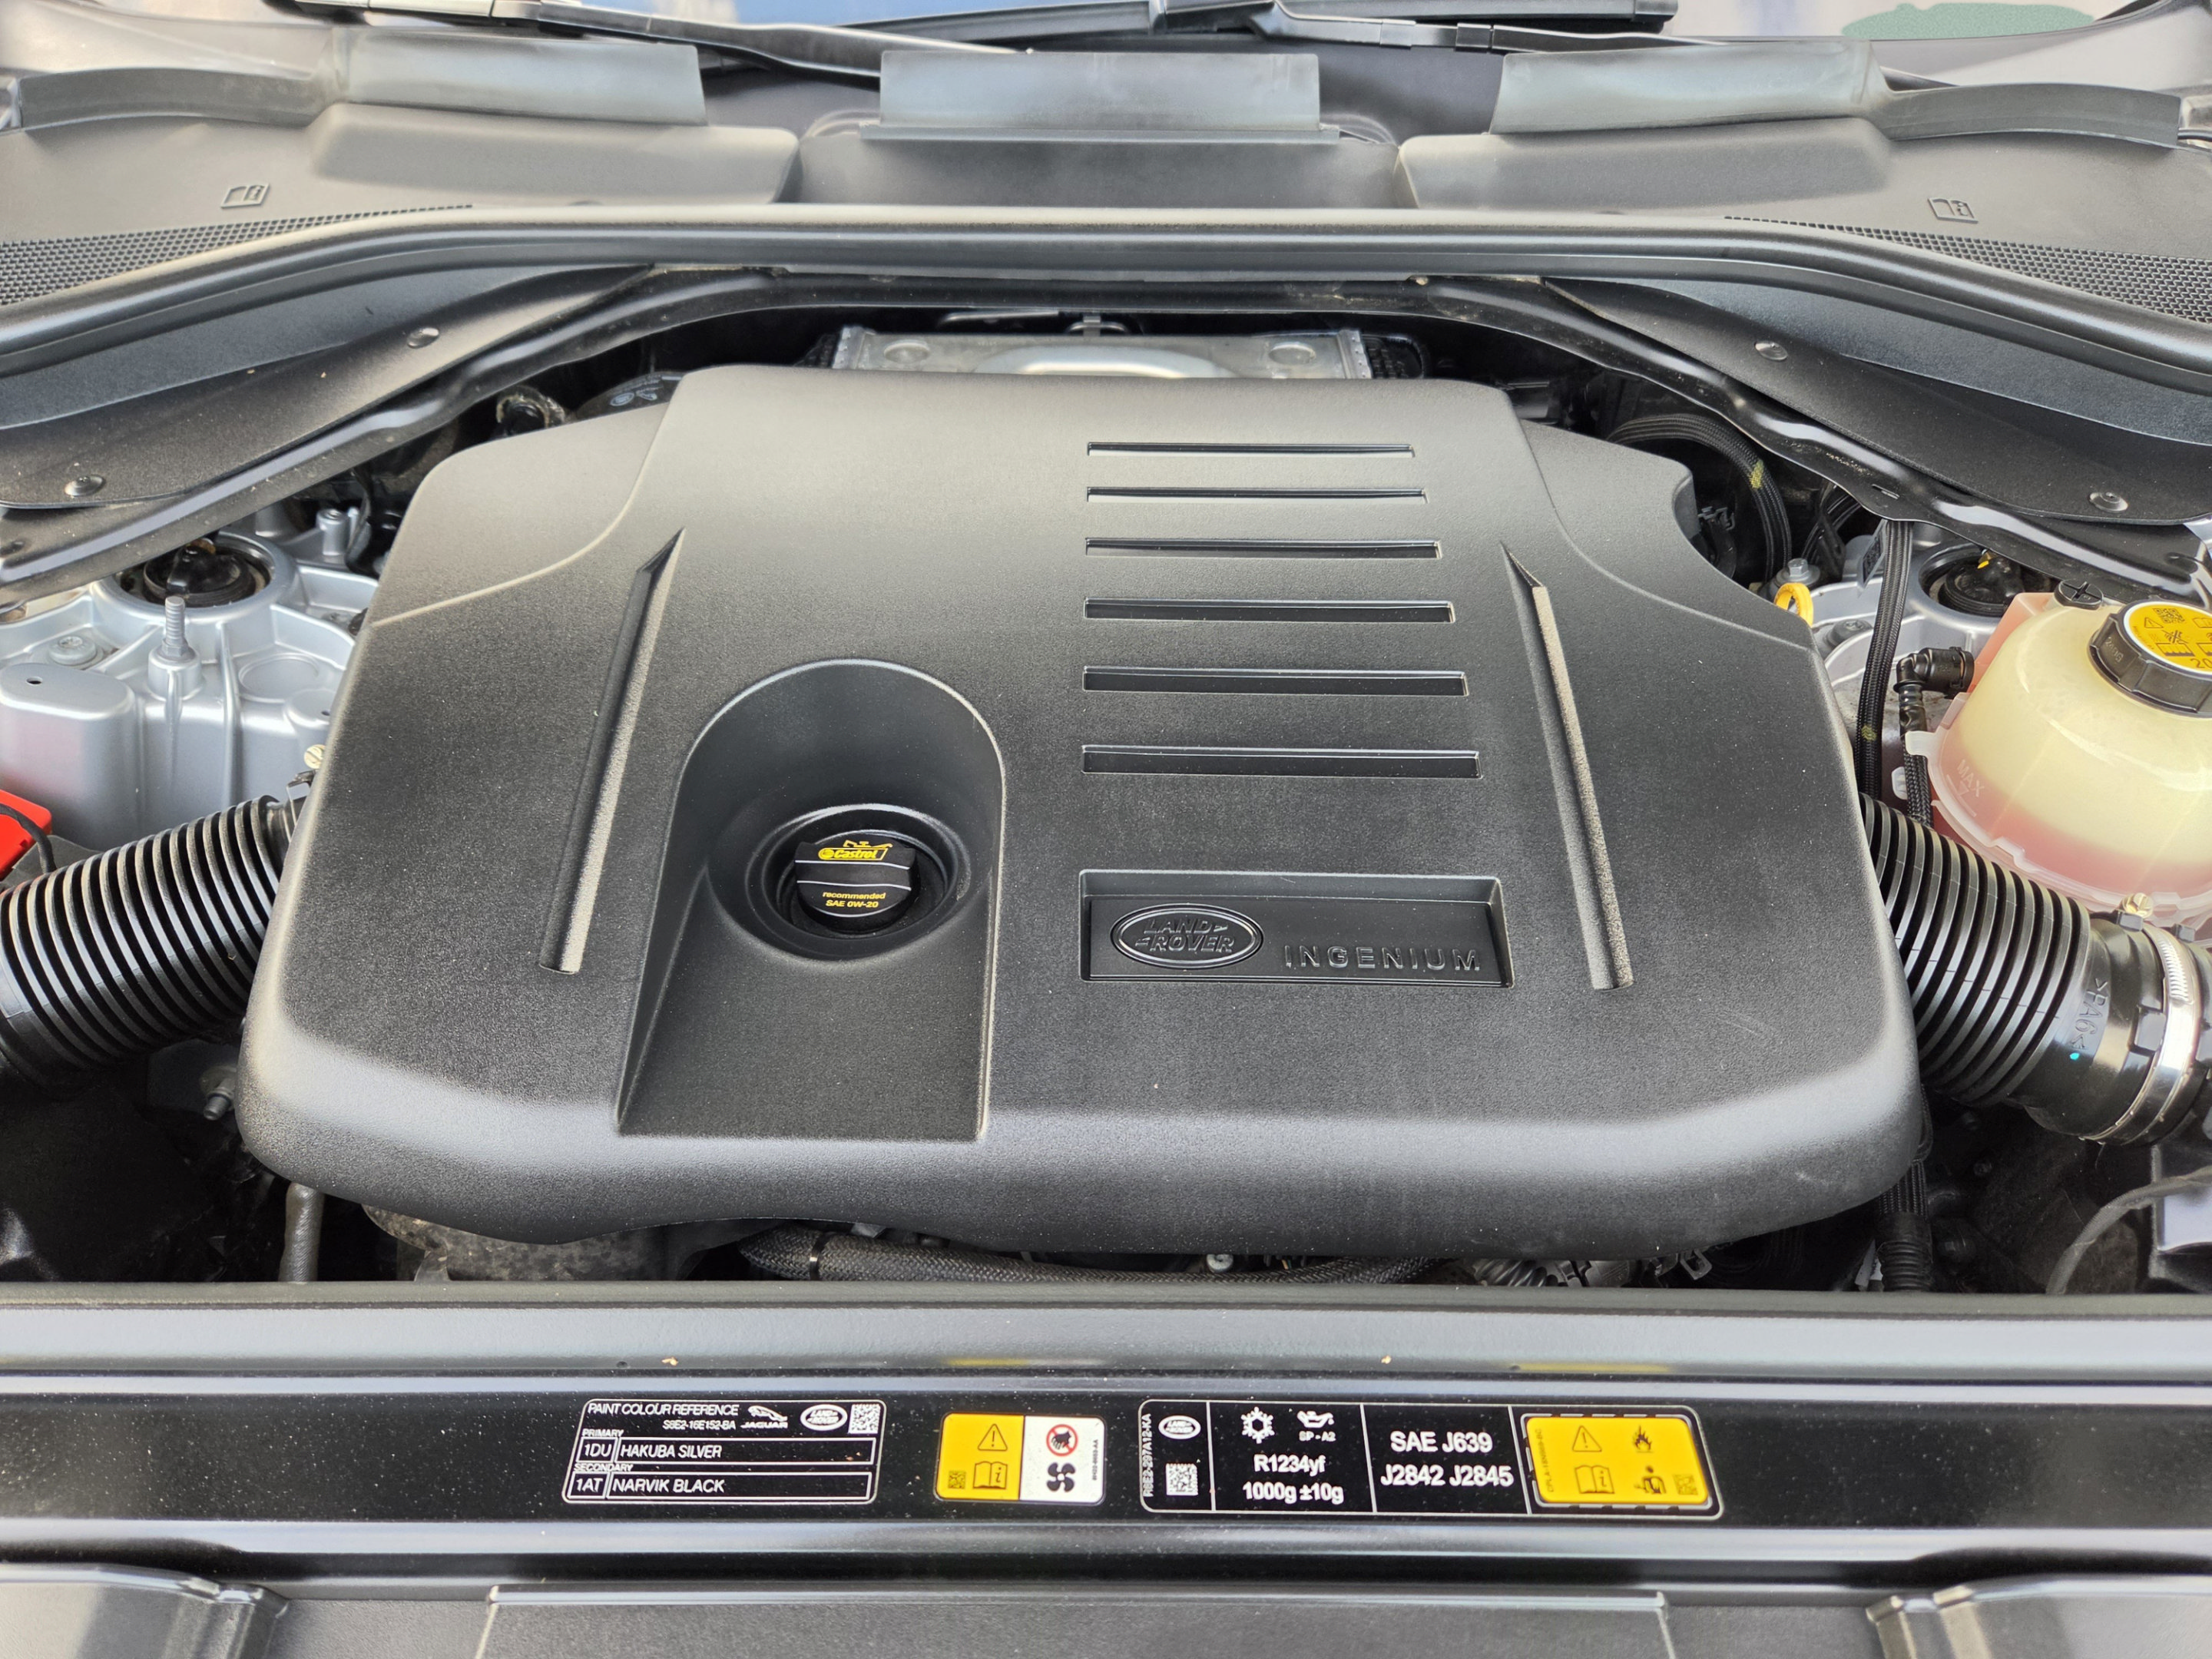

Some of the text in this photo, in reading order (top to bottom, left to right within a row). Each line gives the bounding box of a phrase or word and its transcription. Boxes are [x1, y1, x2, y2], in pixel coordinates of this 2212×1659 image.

[1957, 760, 1985, 797] MAX
[834, 849, 878, 859] Castrol
[1144, 919, 1212, 934] LAND
[1150, 935, 1235, 952] ROVER
[1285, 945, 1480, 971] INGENIUM
[588, 1403, 739, 1416] PAINT COLOUR REFERENCE
[581, 1429, 624, 1437] PRIMARY
[1390, 1431, 1492, 1453] SAE J639
[584, 1443, 612, 1457] 1DU
[620, 1445, 722, 1459] HAKUBA SILVER
[1253, 1453, 1326, 1477] R1234yf
[1380, 1464, 1515, 1487] J2842 J2845
[576, 1478, 603, 1492] 1AT
[612, 1479, 724, 1493] NARVIK BLACK
[1243, 1481, 1344, 1505] 1000g ±10g
